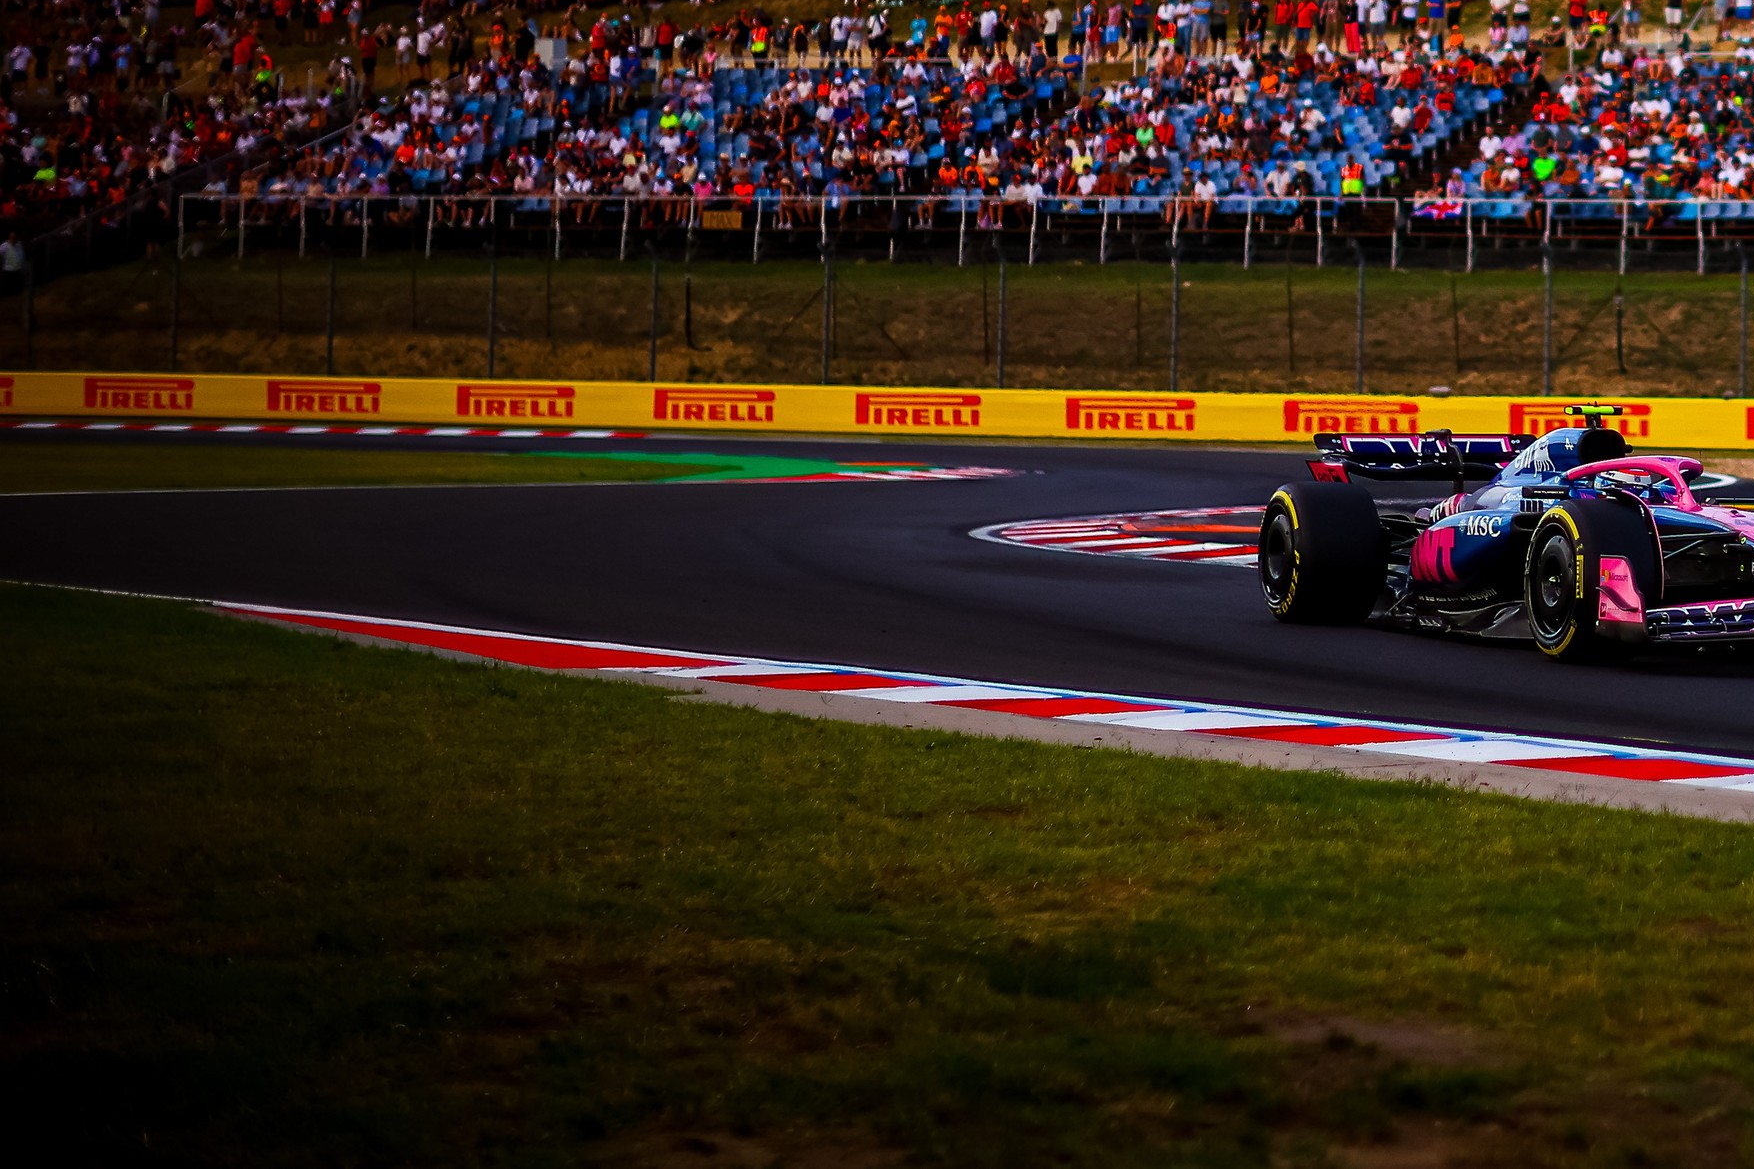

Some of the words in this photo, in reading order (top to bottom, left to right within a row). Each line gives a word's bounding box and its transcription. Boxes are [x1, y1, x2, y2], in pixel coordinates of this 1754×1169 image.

[84, 377, 195, 410] PIRELLI
[266, 380, 382, 414] PIRELLI
[456, 384, 576, 418] PIRELLI
[653, 388, 776, 422] PIRELLI
[855, 393, 981, 427] PIRELLI
[1066, 397, 1196, 431] PIRELLI
[1284, 401, 1419, 433] PIRELLI
[1510, 403, 1651, 437] PIRLI
[1466, 515, 1503, 538] MSC
[1411, 527, 1460, 583] WT
